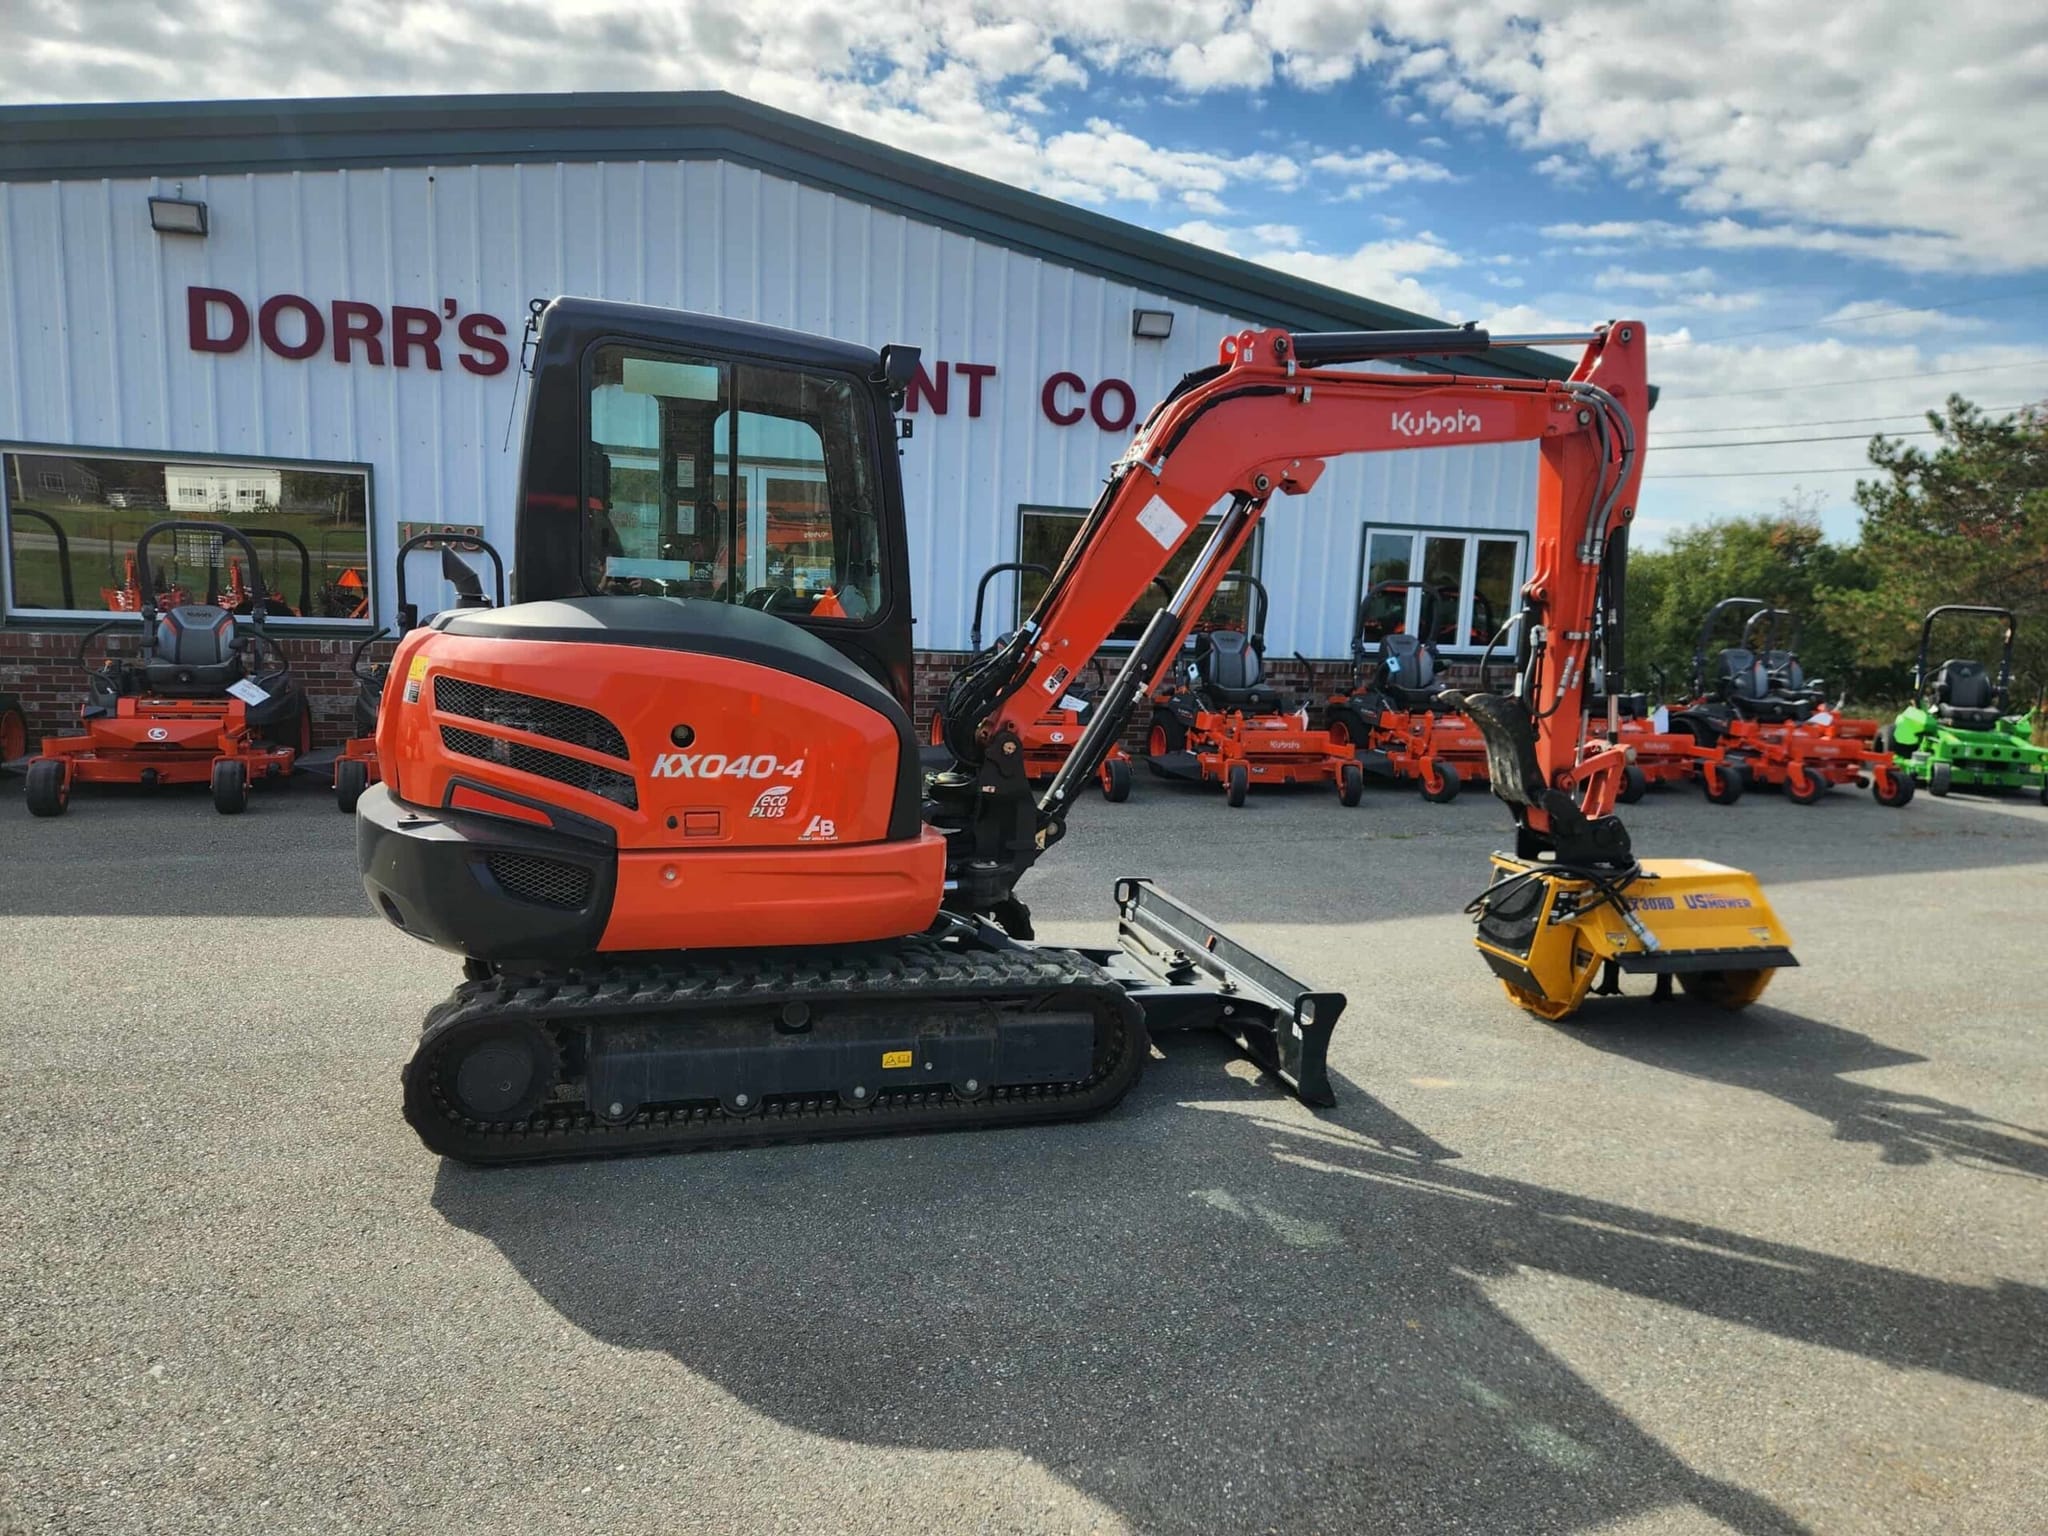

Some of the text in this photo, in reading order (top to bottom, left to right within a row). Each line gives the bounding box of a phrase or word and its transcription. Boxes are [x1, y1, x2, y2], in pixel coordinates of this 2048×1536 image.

[187, 286, 510, 377] DORR'S
[1041, 371, 1142, 432] CO.
[1391, 408, 1481, 436] Kubota
[651, 753, 805, 779] KX040-4
[749, 806, 787, 818] PLUS
[760, 795, 788, 807] eco
